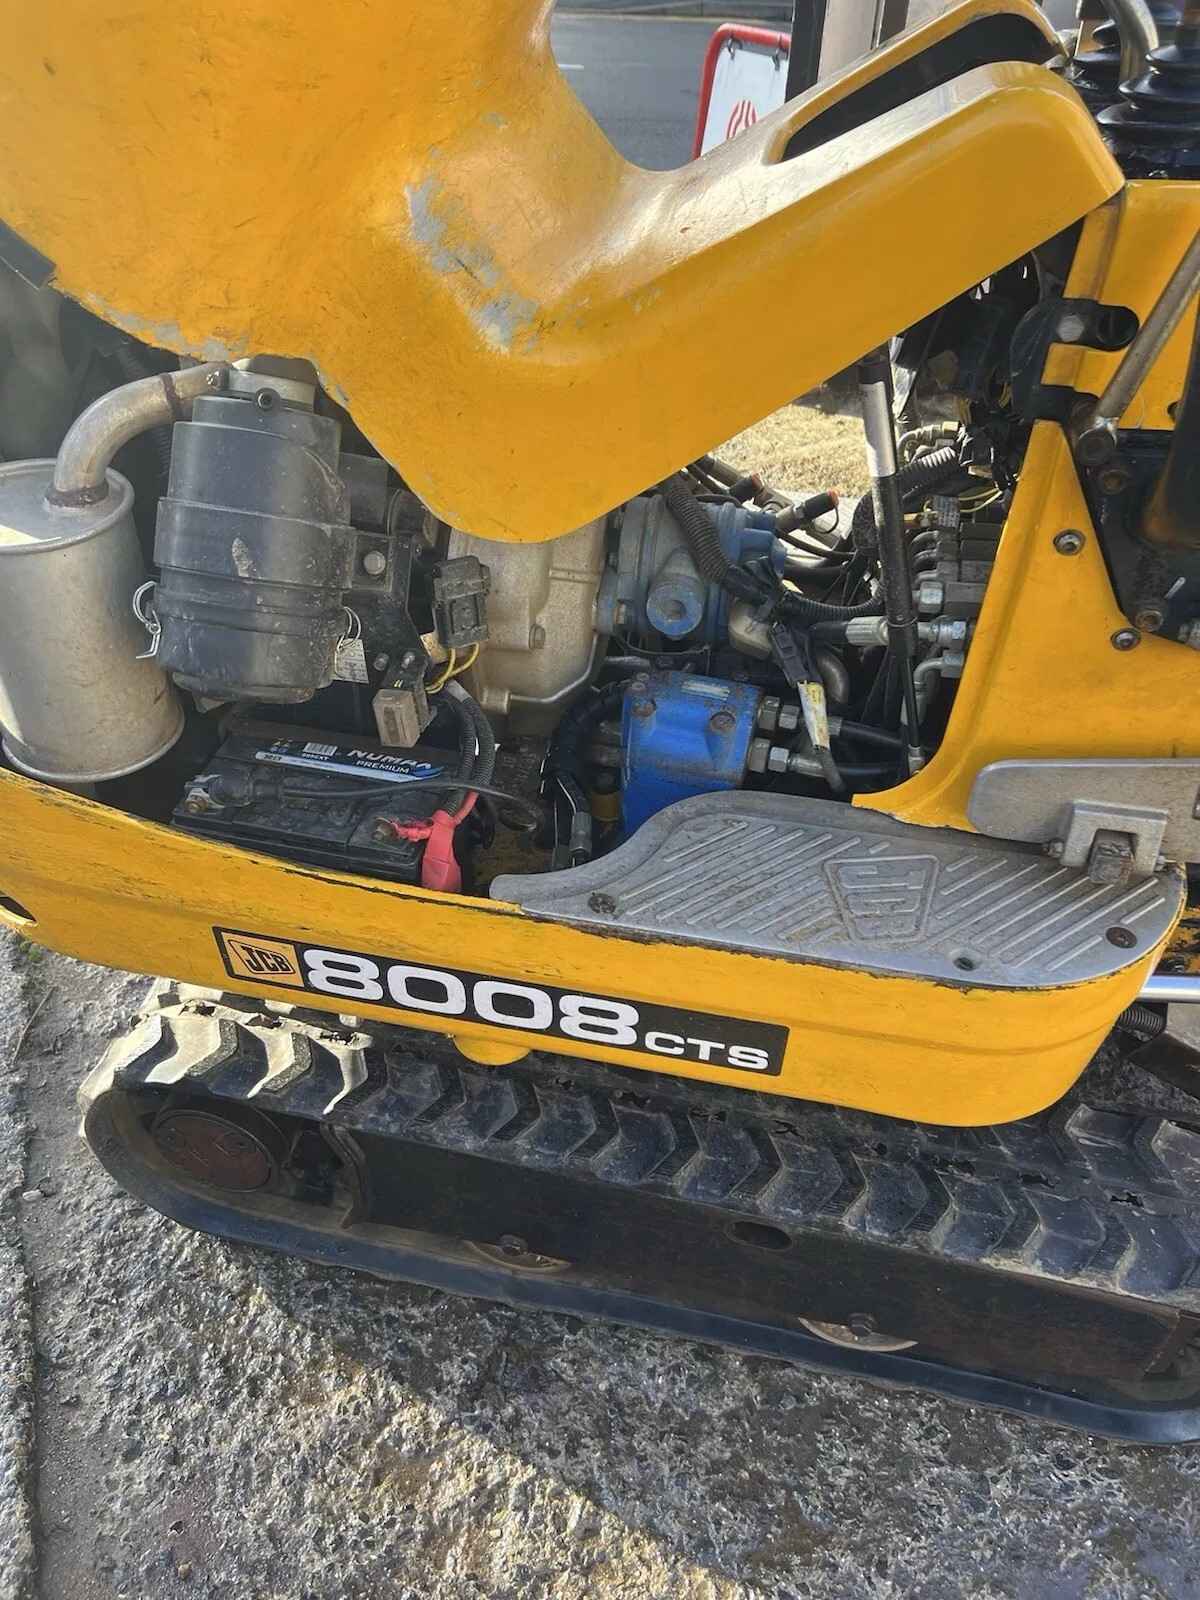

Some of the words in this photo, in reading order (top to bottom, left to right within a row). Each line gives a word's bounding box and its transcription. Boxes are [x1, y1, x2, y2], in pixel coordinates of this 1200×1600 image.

[356, 760, 410, 774] PREMIUM
[240, 945, 291, 972] JCB
[301, 948, 641, 1047] 8008
[643, 1029, 770, 1070] CTS
